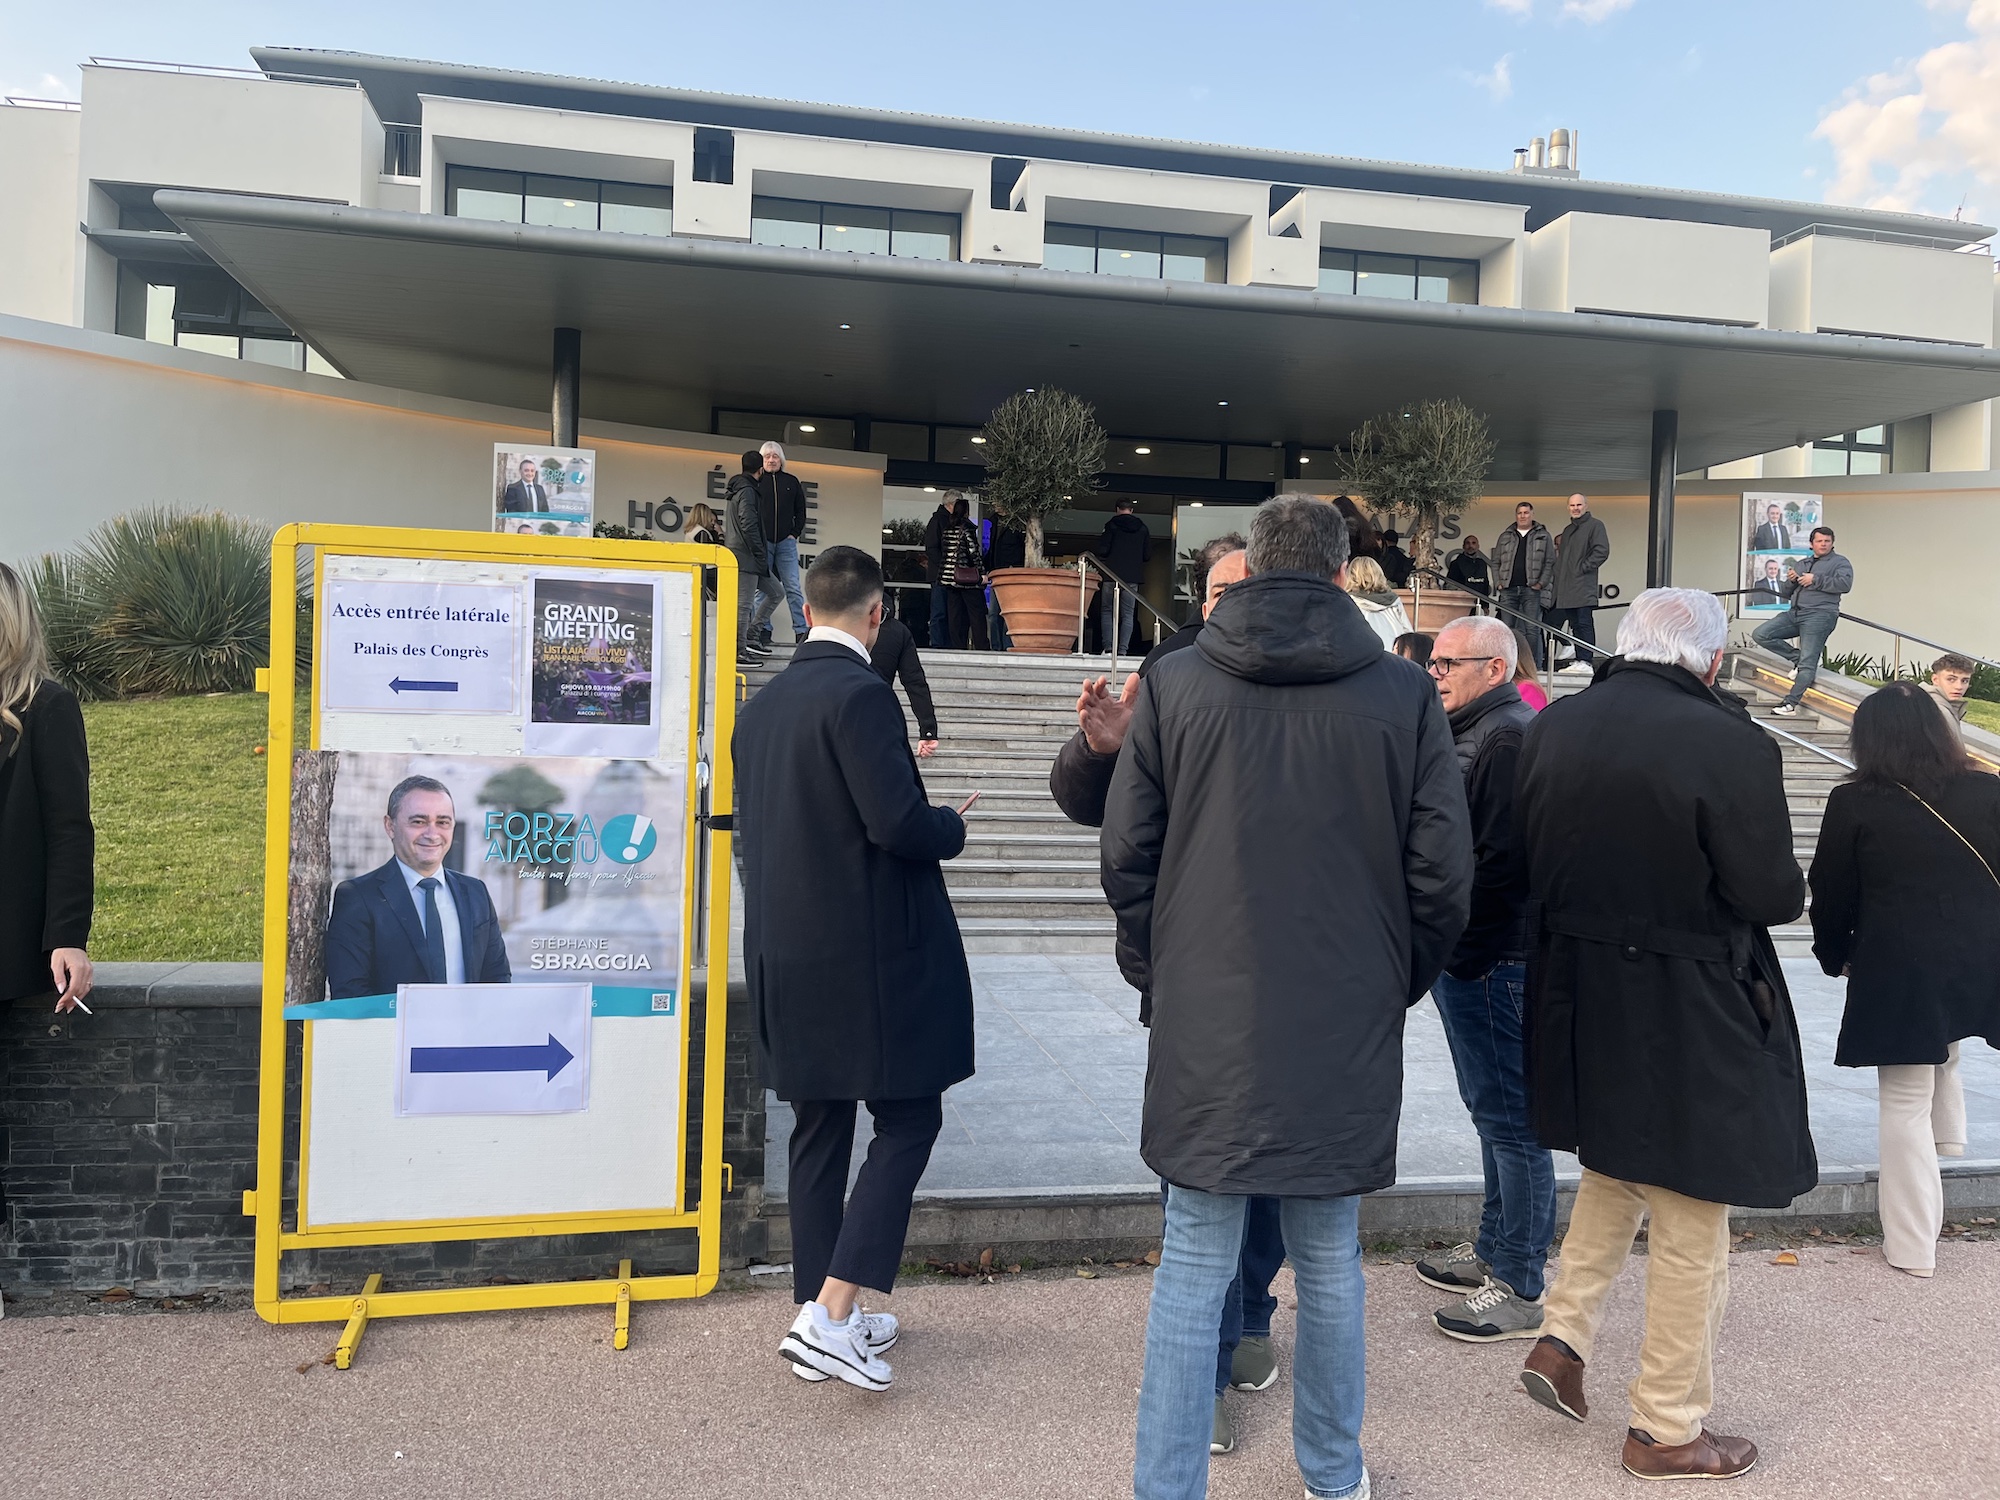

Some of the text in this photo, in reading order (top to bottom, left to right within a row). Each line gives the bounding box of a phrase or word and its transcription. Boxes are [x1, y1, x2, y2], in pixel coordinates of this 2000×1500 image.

[332, 603, 511, 623] Accès entrée latérale
[544, 604, 619, 623] GRAND
[544, 621, 635, 640] MEETING
[353, 642, 489, 660] Palais des Congrès
[543, 646, 567, 654] LISTA
[606, 648, 626, 656] VIVU
[485, 811, 599, 841] FORZA
[485, 839, 600, 864] AIACCIU
[518, 864, 657, 888] toutes nos forces pour Ajaccio
[530, 936, 609, 951] STÉPHANE
[529, 953, 652, 971] SBRAGGIA
